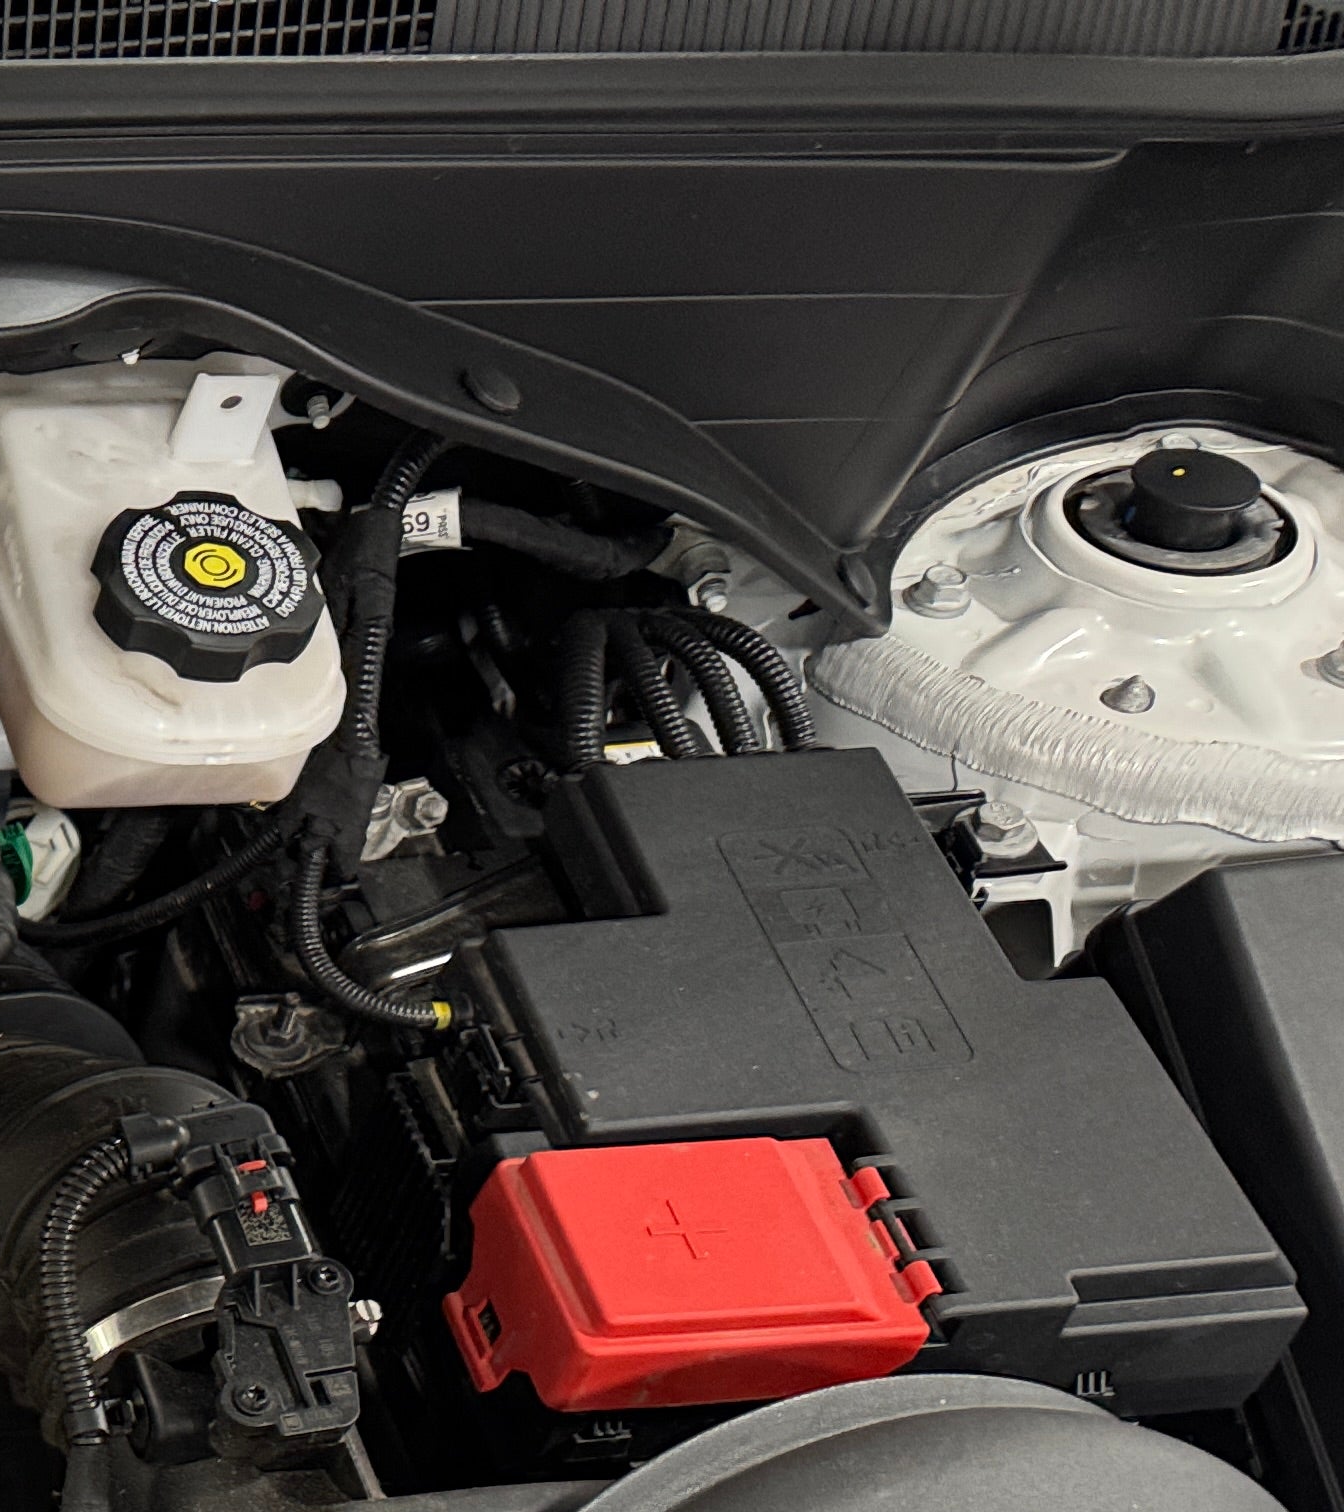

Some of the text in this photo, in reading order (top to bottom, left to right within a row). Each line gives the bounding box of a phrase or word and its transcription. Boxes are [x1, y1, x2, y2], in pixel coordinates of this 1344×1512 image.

[180, 515, 209, 527] ONLY
[210, 515, 234, 528] USE
[238, 511, 282, 538] SEALED
[186, 527, 229, 539] FILLER
[228, 532, 264, 557] CLEAN
[138, 557, 153, 569] DE
[281, 542, 305, 569] FROM
[140, 568, 169, 597] LIQUIDE
[273, 557, 290, 592] BEFORE
[290, 569, 307, 596] FLUID
[144, 596, 163, 610] LE
[161, 592, 180, 606] DU
[175, 599, 199, 615] QUE
[184, 591, 248, 608] PROVENANT
[262, 588, 283, 608] CAP
[158, 604, 212, 632] NETTOYER
